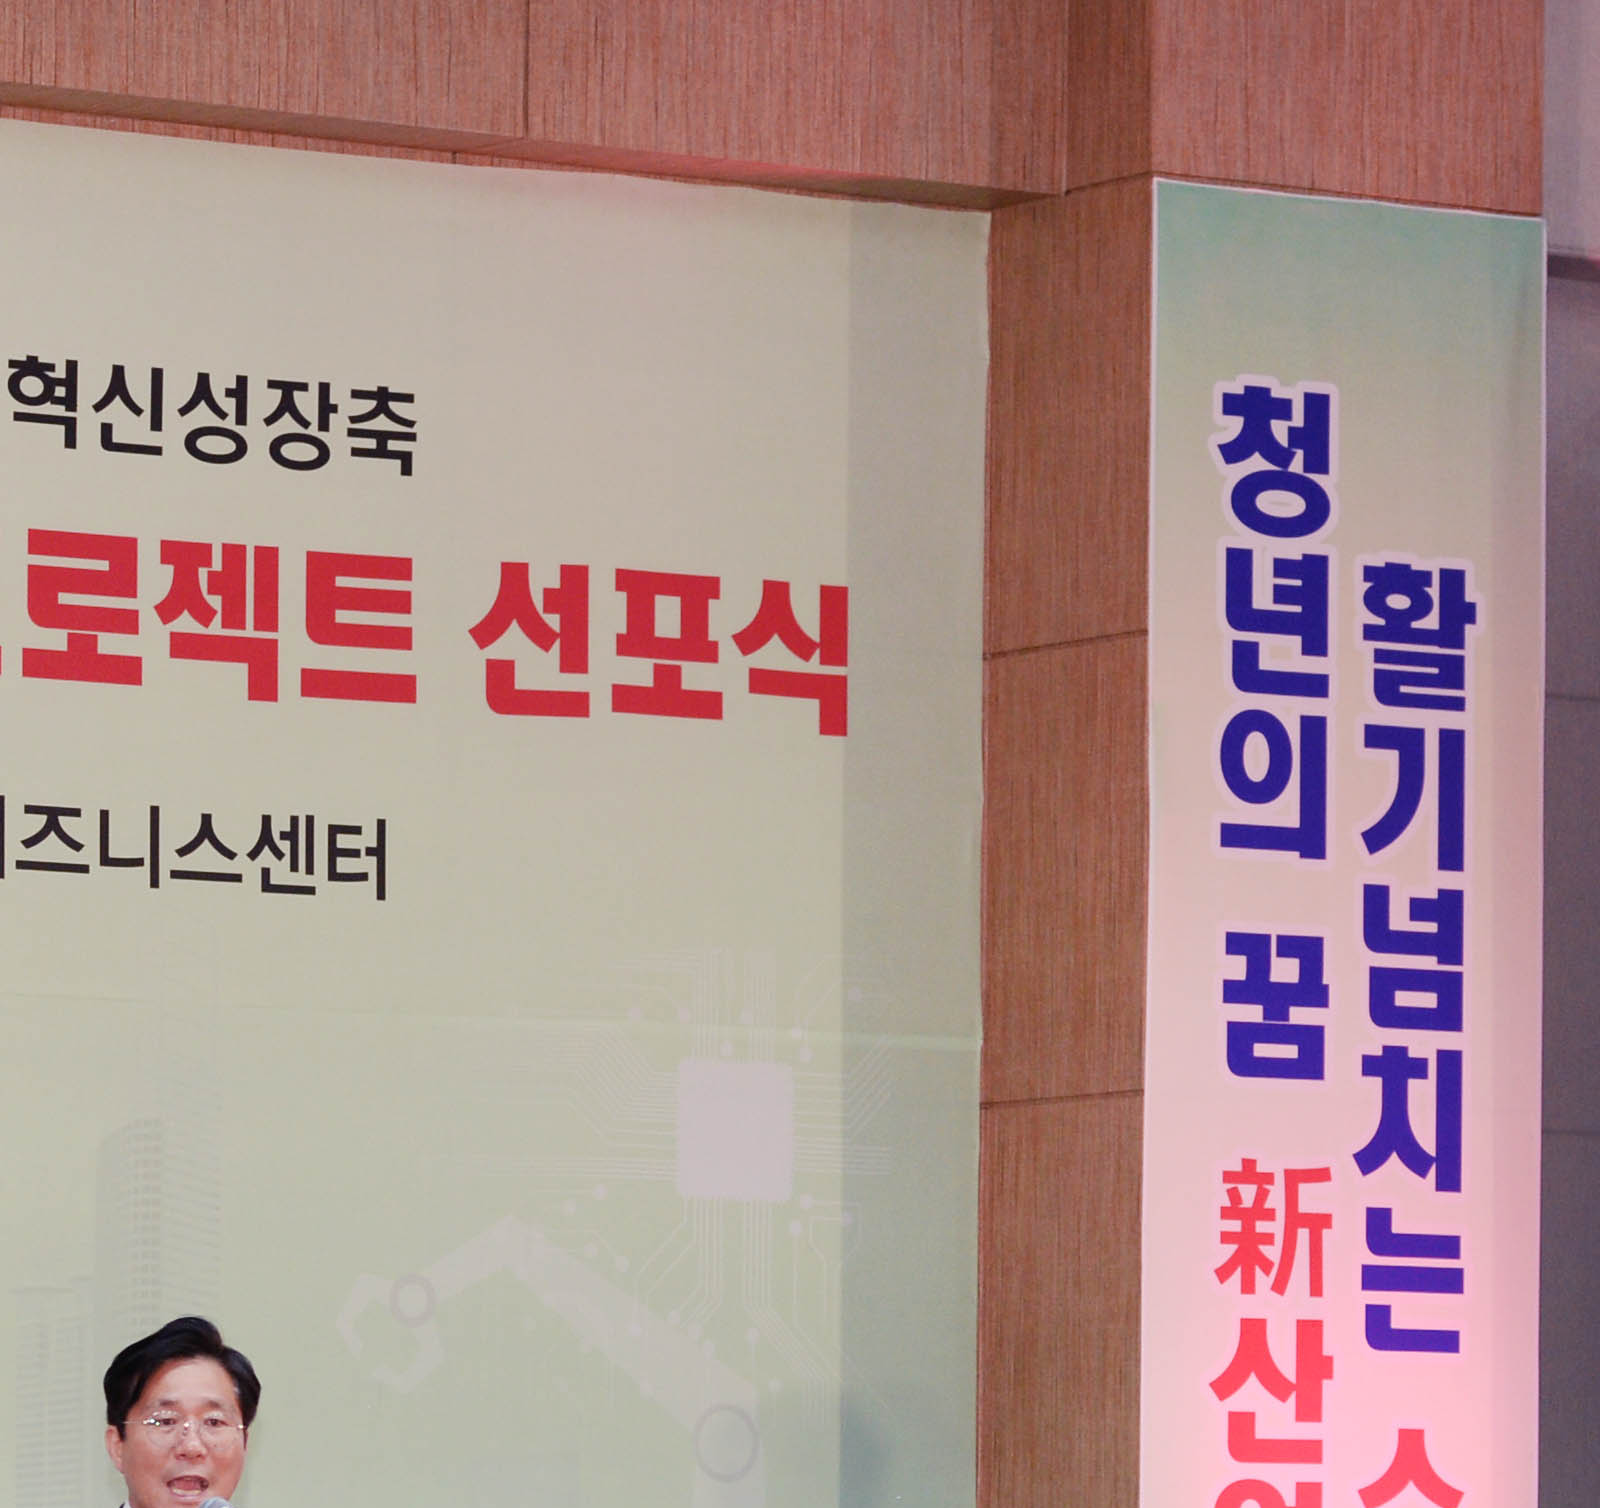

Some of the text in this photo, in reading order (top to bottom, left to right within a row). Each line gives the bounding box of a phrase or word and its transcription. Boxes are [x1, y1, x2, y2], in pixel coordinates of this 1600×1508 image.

[7, 354, 418, 477] 혁신성장축
[468, 561, 849, 737] 선포식
[1217, 385, 1331, 860] 청년의
[1222, 931, 1330, 1080] 꿈
[1352, 561, 1477, 1354] 활기넘치는
